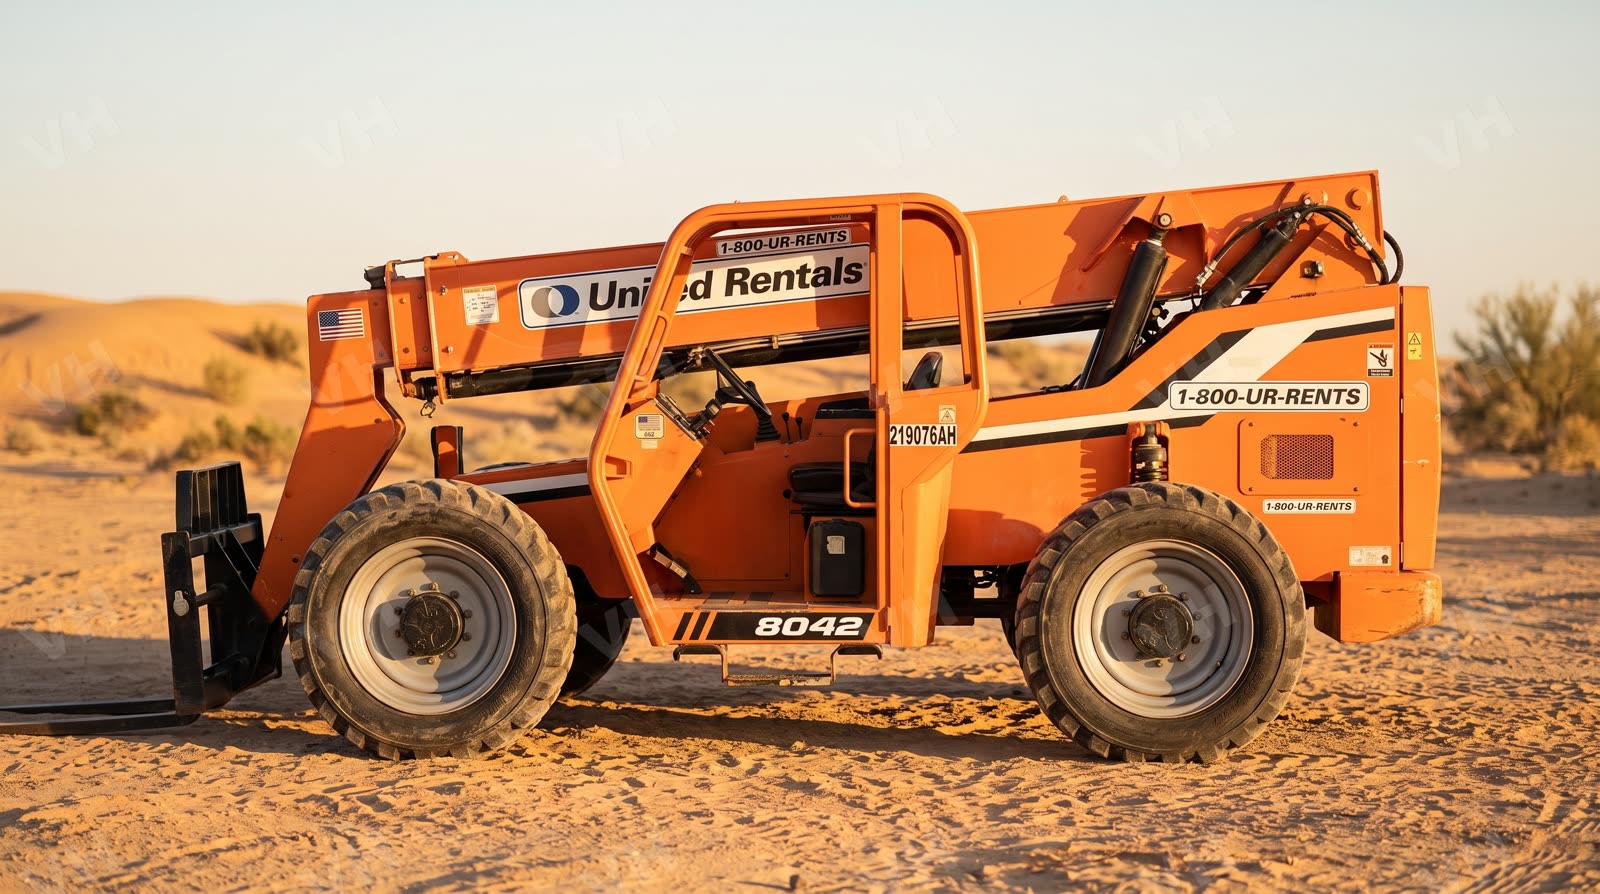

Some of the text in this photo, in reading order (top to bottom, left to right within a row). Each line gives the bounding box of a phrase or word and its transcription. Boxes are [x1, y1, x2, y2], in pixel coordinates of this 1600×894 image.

[721, 230, 847, 254] 1-800-UR-RENTS
[589, 257, 863, 311] Unid Rentals
[1177, 388, 1361, 405] 1-800-UR-RENTS
[889, 425, 956, 445] 219076AH
[1266, 502, 1352, 511] 1-800-UR-RENTS
[754, 616, 864, 637] 8042
